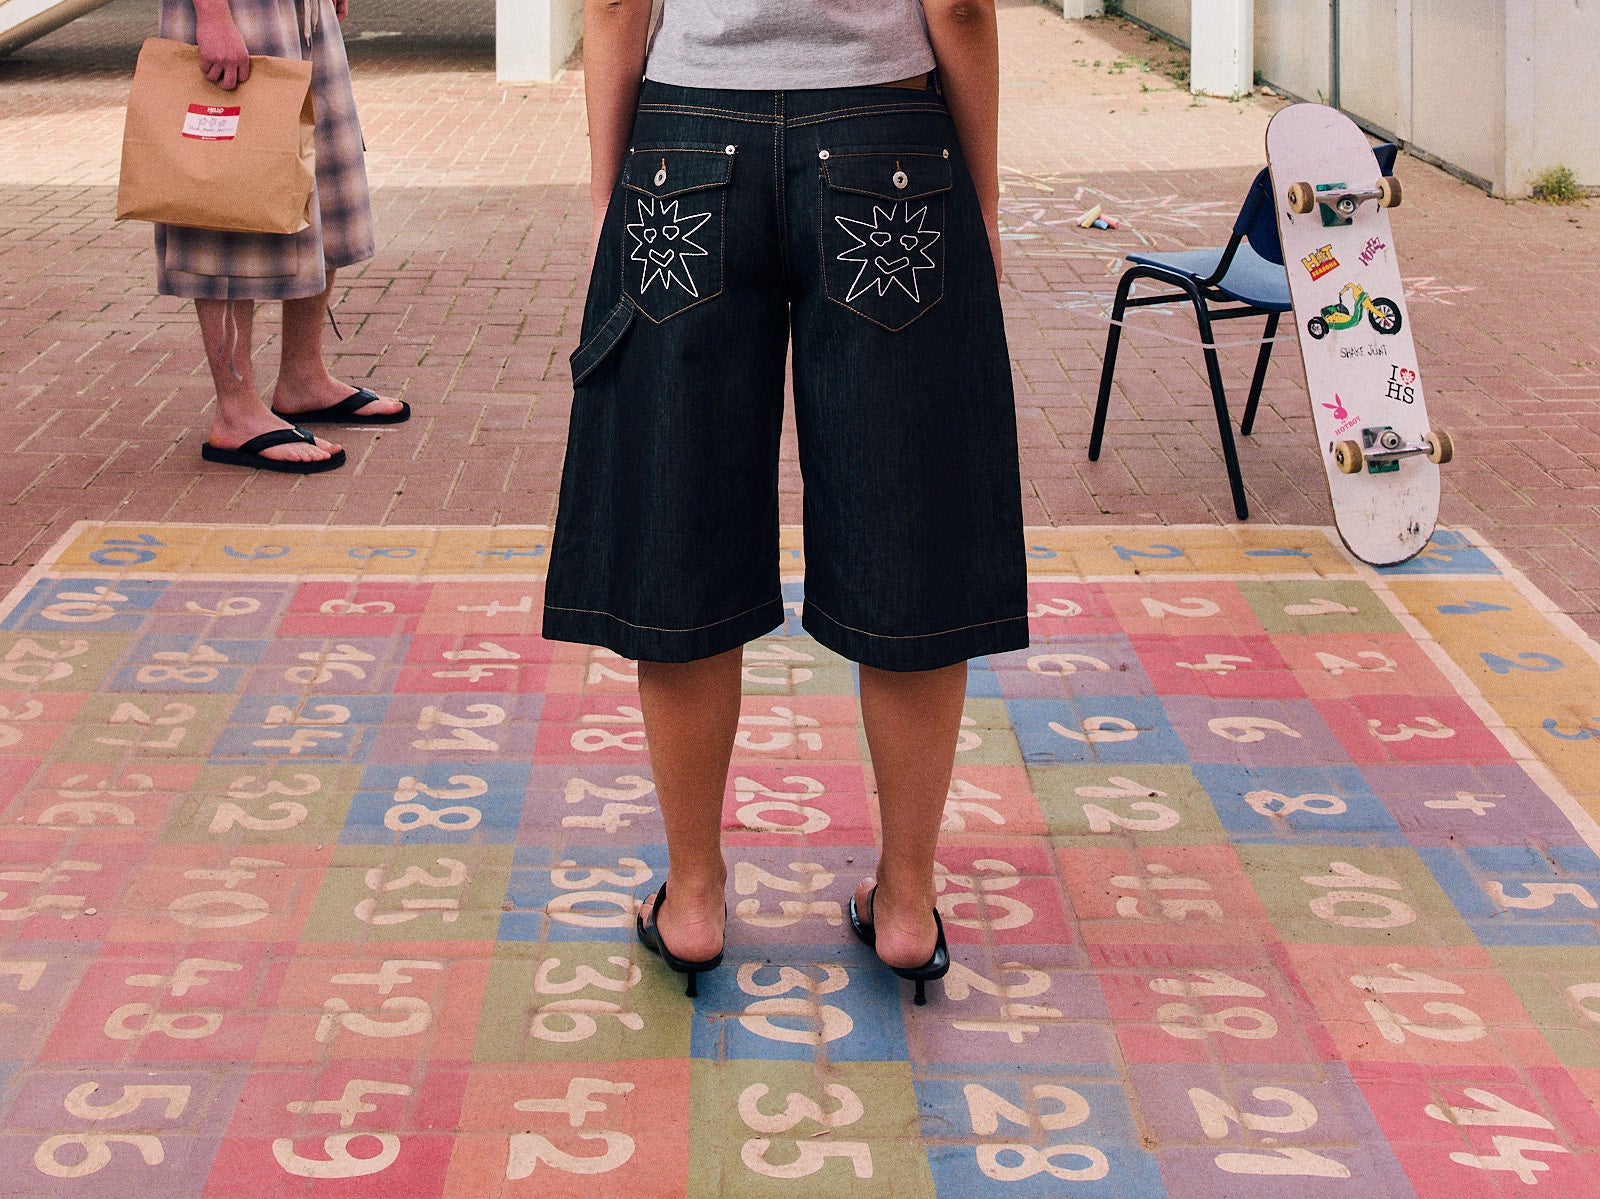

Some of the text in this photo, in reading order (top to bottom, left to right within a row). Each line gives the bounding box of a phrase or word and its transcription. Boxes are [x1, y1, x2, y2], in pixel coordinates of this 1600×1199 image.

[1311, 260, 1339, 278] SEASONS
[1385, 380, 1415, 405] HS
[1389, 364, 1399, 381] I
[1334, 415, 1361, 436] HOTBOY
[90, 534, 167, 567] 10
[348, 546, 417, 560] 8
[1113, 545, 1185, 562] 2
[1245, 547, 1312, 557] 1
[41, 586, 128, 623] 10
[186, 596, 260, 617] 9
[320, 598, 396, 616] 8
[457, 596, 532, 618] 7
[1141, 597, 1221, 619] 2
[1284, 598, 1359, 616] 1
[1436, 600, 1512, 615] 1
[0, 638, 90, 683] 20
[136, 644, 229, 684] 18
[284, 643, 377, 685] 16
[432, 642, 522, 683] 14
[1026, 653, 1111, 676] 6
[1176, 653, 1252, 676] 4
[1316, 651, 1399, 676] 2
[1478, 652, 1567, 675] 2
[94, 702, 197, 748] 27
[253, 704, 351, 754] 24
[412, 703, 508, 752] 21
[570, 705, 650, 752] 18
[734, 706, 824, 752] 15
[1048, 715, 1141, 743] 9
[1208, 715, 1301, 744] 6
[1368, 715, 1456, 743] 3
[208, 773, 321, 835] 32
[384, 774, 489, 833] 28
[561, 775, 656, 834] 24
[734, 775, 832, 835] 20
[1074, 776, 1180, 834] 12
[1244, 789, 1348, 818] 8
[1424, 790, 1506, 816] 4
[168, 856, 286, 928] 40
[354, 858, 470, 925] 35
[546, 857, 653, 929] 30
[734, 861, 843, 928] 25
[1110, 863, 1224, 924] 15
[1300, 861, 1417, 929] 10
[1484, 880, 1599, 910] 5
[103, 958, 243, 1040] 48
[314, 958, 444, 1044] 42
[528, 956, 645, 1044] 36
[736, 961, 854, 1046] 30
[943, 960, 1063, 1044] 24
[1149, 968, 1279, 1040] 18
[1349, 962, 1488, 1044] 12
[33, 1080, 192, 1179] 56
[272, 1079, 414, 1179] 49
[505, 1077, 637, 1181] 42
[737, 1082, 874, 1180] 35
[962, 1083, 1110, 1183] 28
[1187, 1085, 1352, 1178] 21
[1424, 1087, 1571, 1186] 14
